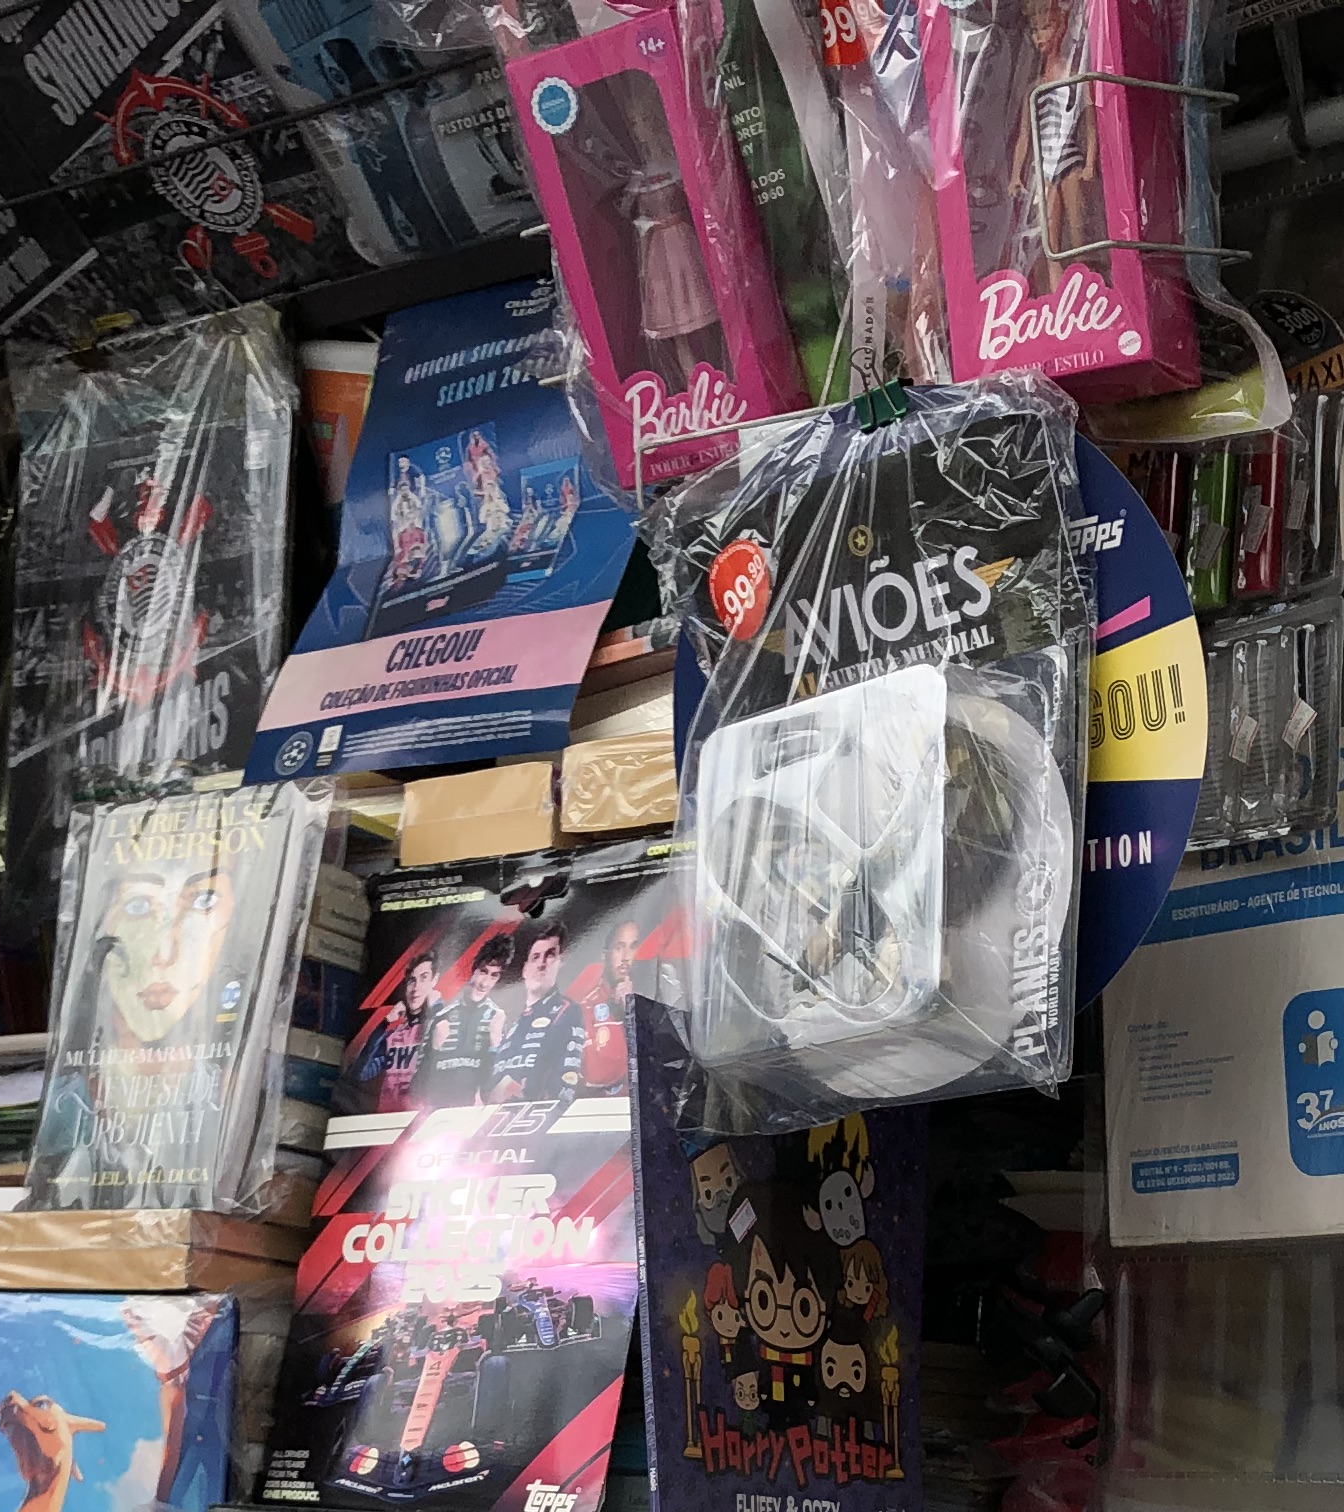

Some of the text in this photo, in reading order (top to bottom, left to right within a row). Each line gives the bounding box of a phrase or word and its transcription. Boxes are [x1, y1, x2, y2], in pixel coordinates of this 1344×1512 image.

[979, 271, 1122, 362] Barbie
[625, 380, 748, 454] Barbie
[784, 545, 991, 675] AVIÕES
[385, 628, 486, 673] CHEGOU!
[467, 664, 519, 690] OFICIAL
[1172, 898, 1239, 921] ESCRITURÁRIO
[1247, 891, 1285, 909] AGENTE
[385, 1175, 557, 1220] STICKER
[343, 1217, 595, 1262] COLLECTION
[699, 1413, 893, 1486] Harry Potter
